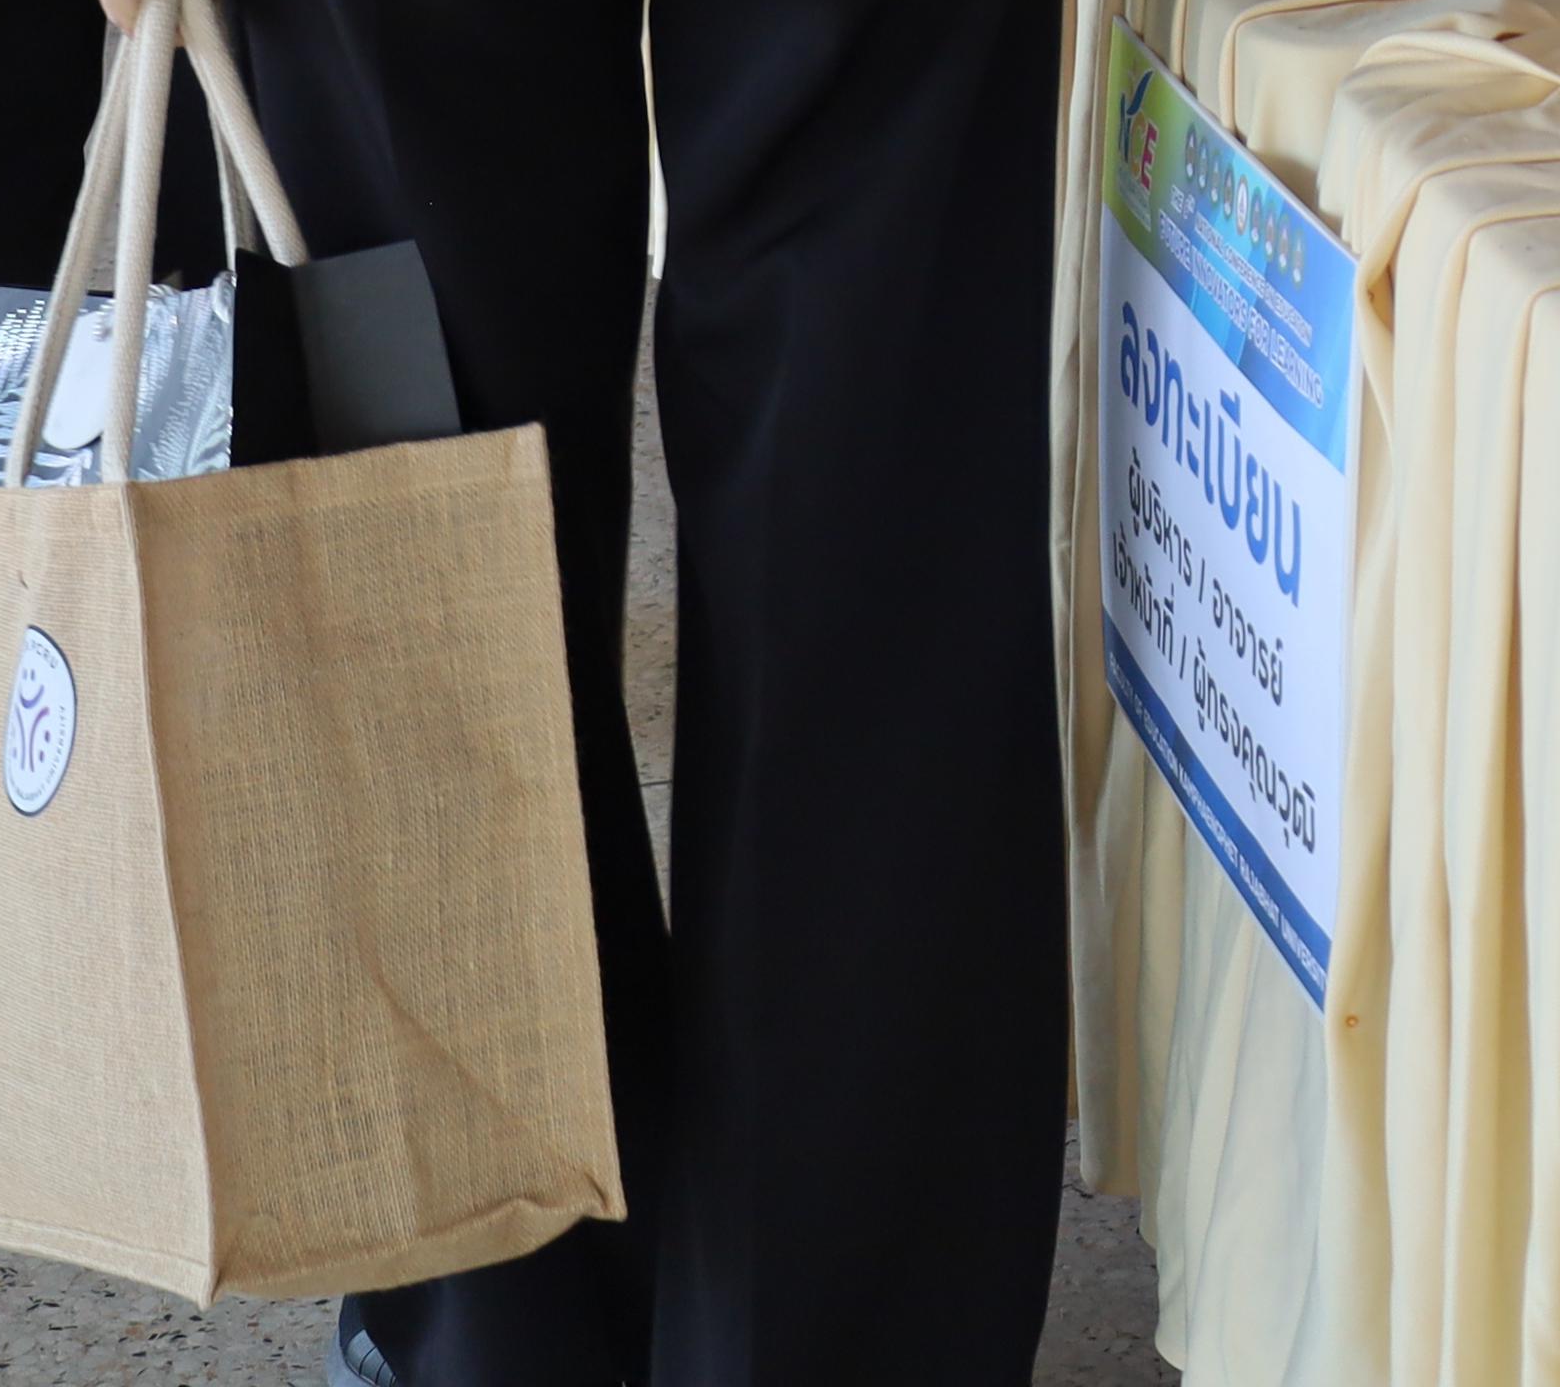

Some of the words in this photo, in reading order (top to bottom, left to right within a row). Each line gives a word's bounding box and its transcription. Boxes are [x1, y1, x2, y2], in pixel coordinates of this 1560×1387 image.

[1120, 300, 1302, 609] ลงทะเบียน
[1246, 300, 1270, 355] FOR
[1268, 323, 1324, 414] LEARNING
[1112, 520, 1175, 666] เจ้าหน้าที่
[1193, 635, 1316, 855] ผู้ทรงคุณวุฒิ
[1128, 446, 1192, 587] ผู้บริหาร
[1212, 578, 1284, 707] อาจารย์
